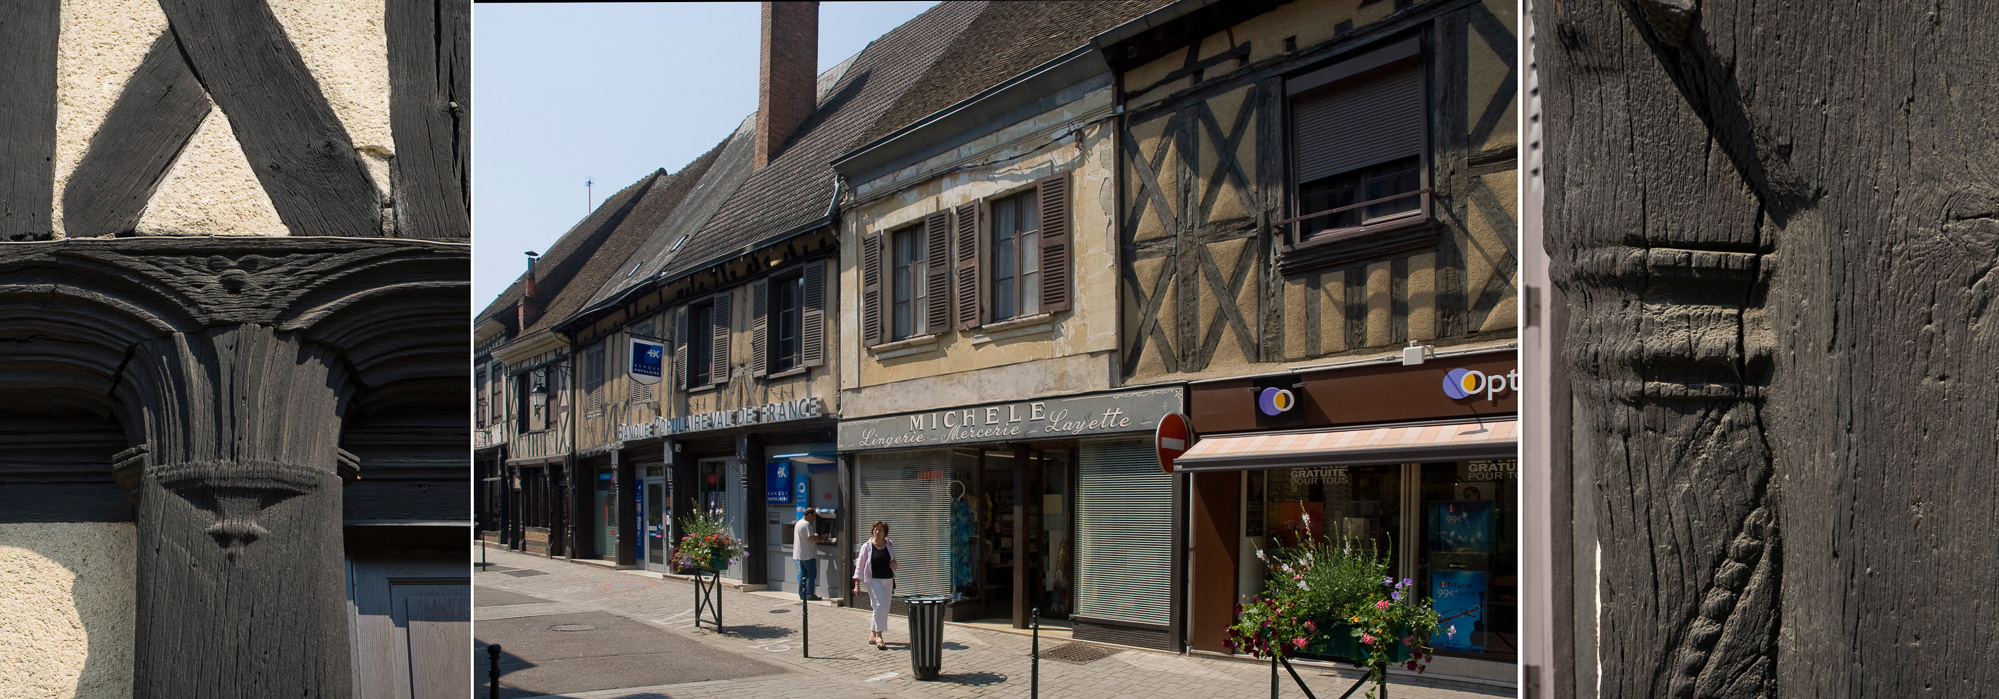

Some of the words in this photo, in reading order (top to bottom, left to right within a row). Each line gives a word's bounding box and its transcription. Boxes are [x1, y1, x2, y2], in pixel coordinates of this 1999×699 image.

[634, 363, 660, 371] BANQUE
[634, 368, 660, 376] POPULAIRE
[1461, 368, 1518, 401] Opt
[618, 422, 650, 441] BANQUE
[654, 413, 708, 437] POPULAIRE
[711, 410, 731, 429] VAL
[737, 406, 754, 426] DE
[760, 397, 818, 423] FRANCE
[908, 401, 1046, 432] MICHELE
[859, 428, 926, 449] Lingerie
[940, 422, 1021, 443] Mercerie
[1044, 407, 1132, 435] Layette
[1290, 478, 1318, 486] POUR
[1322, 476, 1348, 485] TOUS
[1468, 472, 1503, 481] POUR
[1447, 582, 1473, 590] titane
